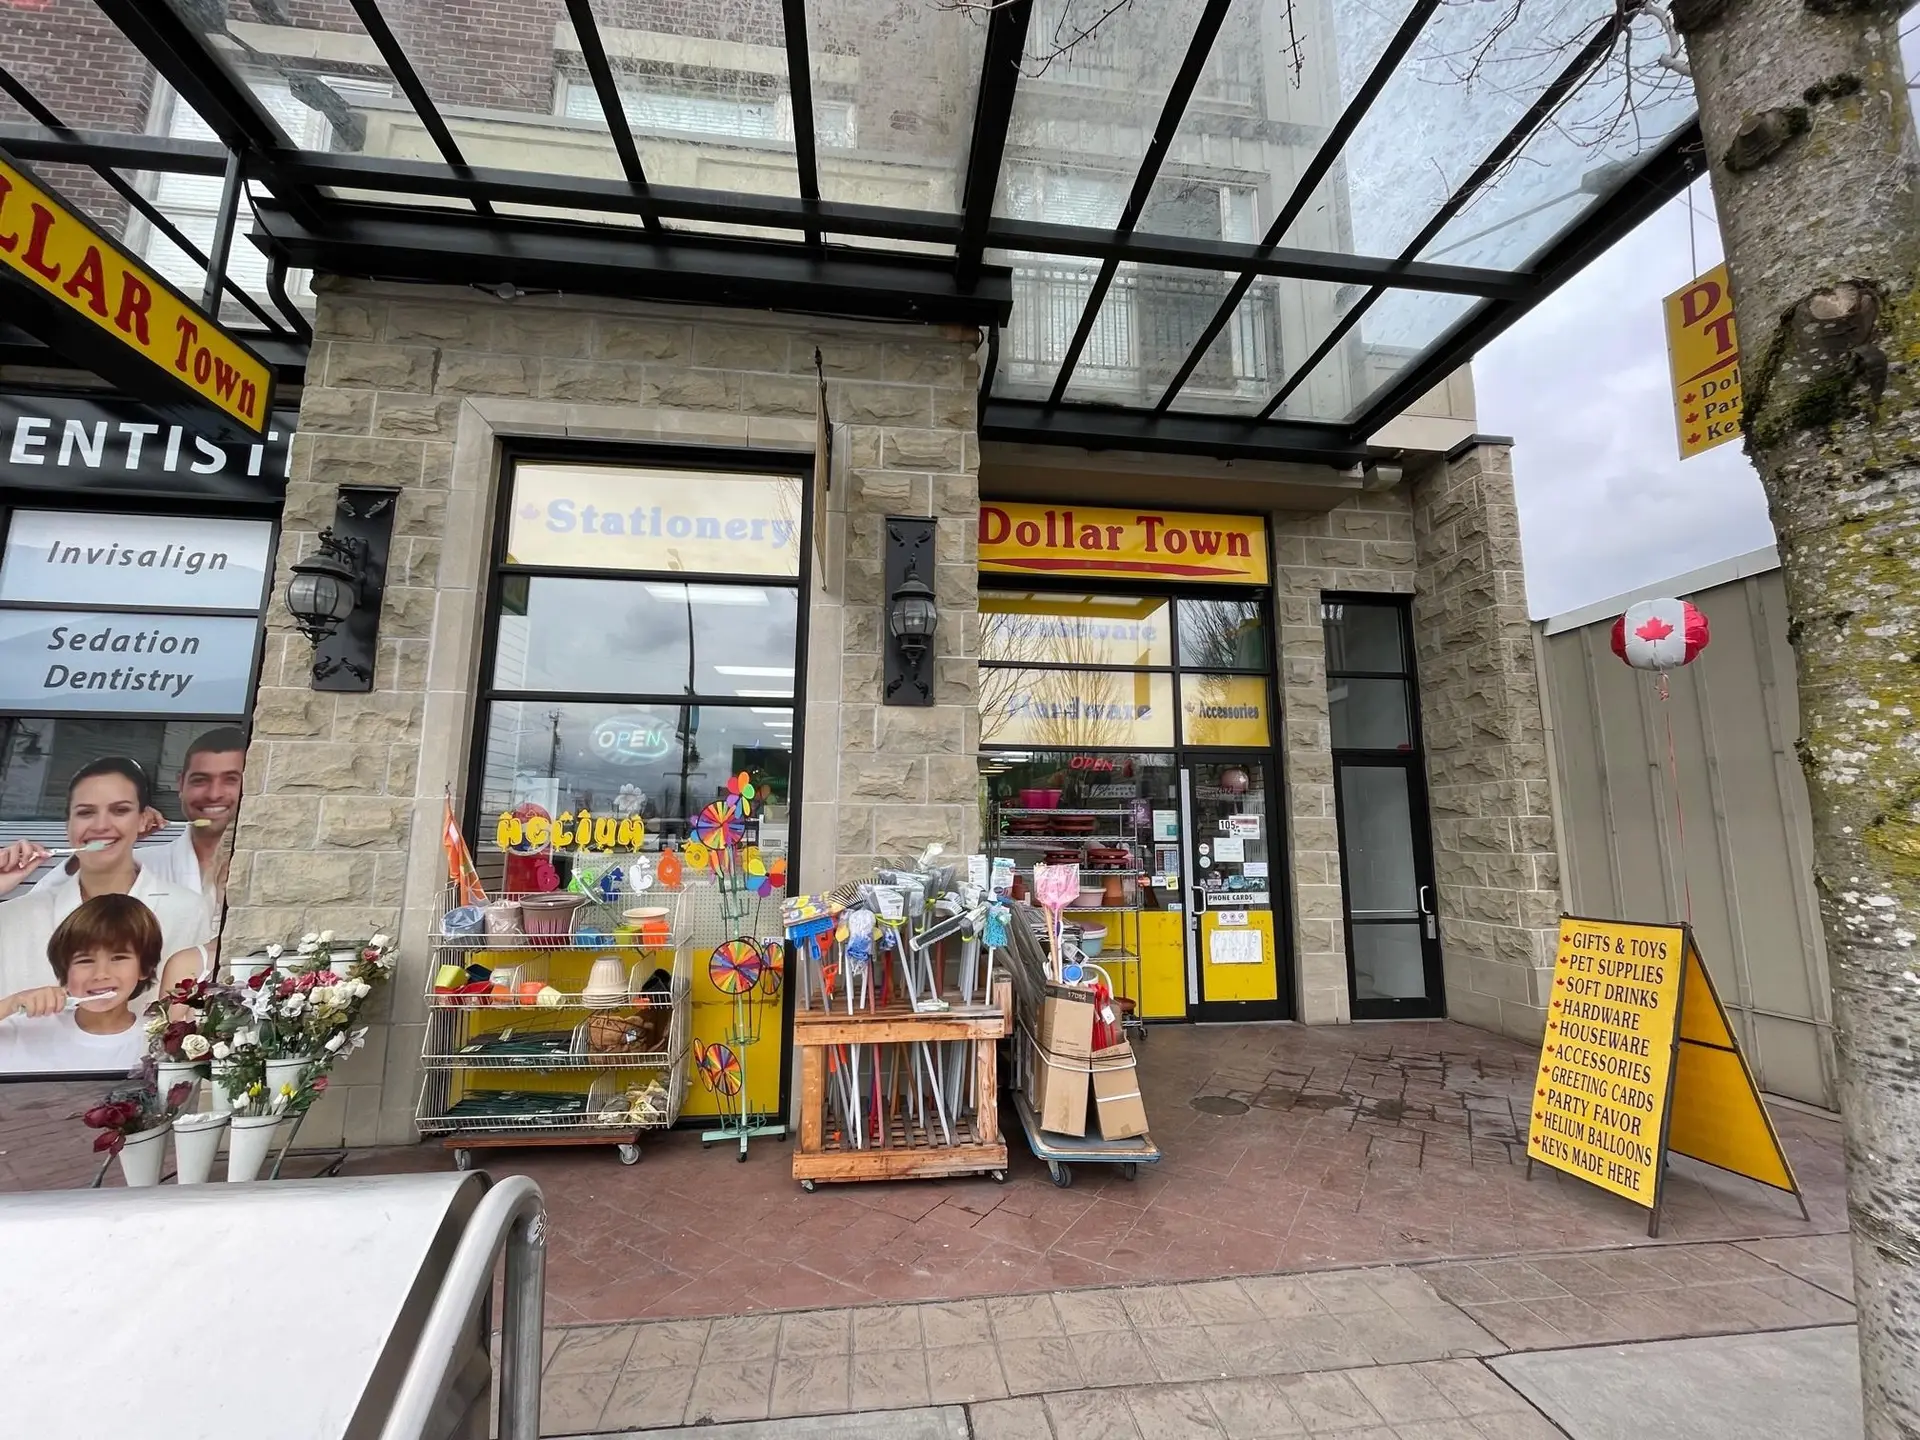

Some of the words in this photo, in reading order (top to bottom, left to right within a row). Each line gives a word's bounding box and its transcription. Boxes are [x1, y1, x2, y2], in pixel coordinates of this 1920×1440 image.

[1680, 281, 1731, 329] D
[174, 314, 257, 419] Town
[546, 498, 795, 549] Stationery
[978, 506, 1124, 551] Dollar
[1136, 515, 1252, 557] Town
[47, 540, 229, 575] Invisalign
[47, 626, 201, 655] Sedation
[43, 664, 194, 698] Dentistry
[1198, 701, 1260, 720] Accessories
[598, 729, 662, 748] OPEN
[1071, 755, 1113, 772] OPEN
[1573, 932, 1610, 953] GIFTS
[1615, 937, 1625, 954] &
[1631, 939, 1667, 960] TOYS
[1569, 954, 1594, 973] PET
[1598, 959, 1663, 985] SUPPLIES
[1566, 976, 1601, 997] SOFT
[1605, 983, 1658, 1009] DRINKS
[1562, 998, 1640, 1031] HARDWARE
[1559, 1020, 1650, 1057] HOUSEWARE
[1555, 1044, 1652, 1084] ACCESSORIES
[1551, 1066, 1608, 1098] GREETING
[1611, 1083, 1654, 1113] CARDS
[1547, 1089, 1590, 1118] PARTY
[1593, 1104, 1641, 1137] FAVOR
[1543, 1111, 1585, 1142] HELIUM
[1587, 1126, 1652, 1167] BALLOONS
[1541, 1135, 1569, 1161] KEYS
[1571, 1146, 1603, 1176] MADE
[1607, 1161, 1641, 1192] HERE
